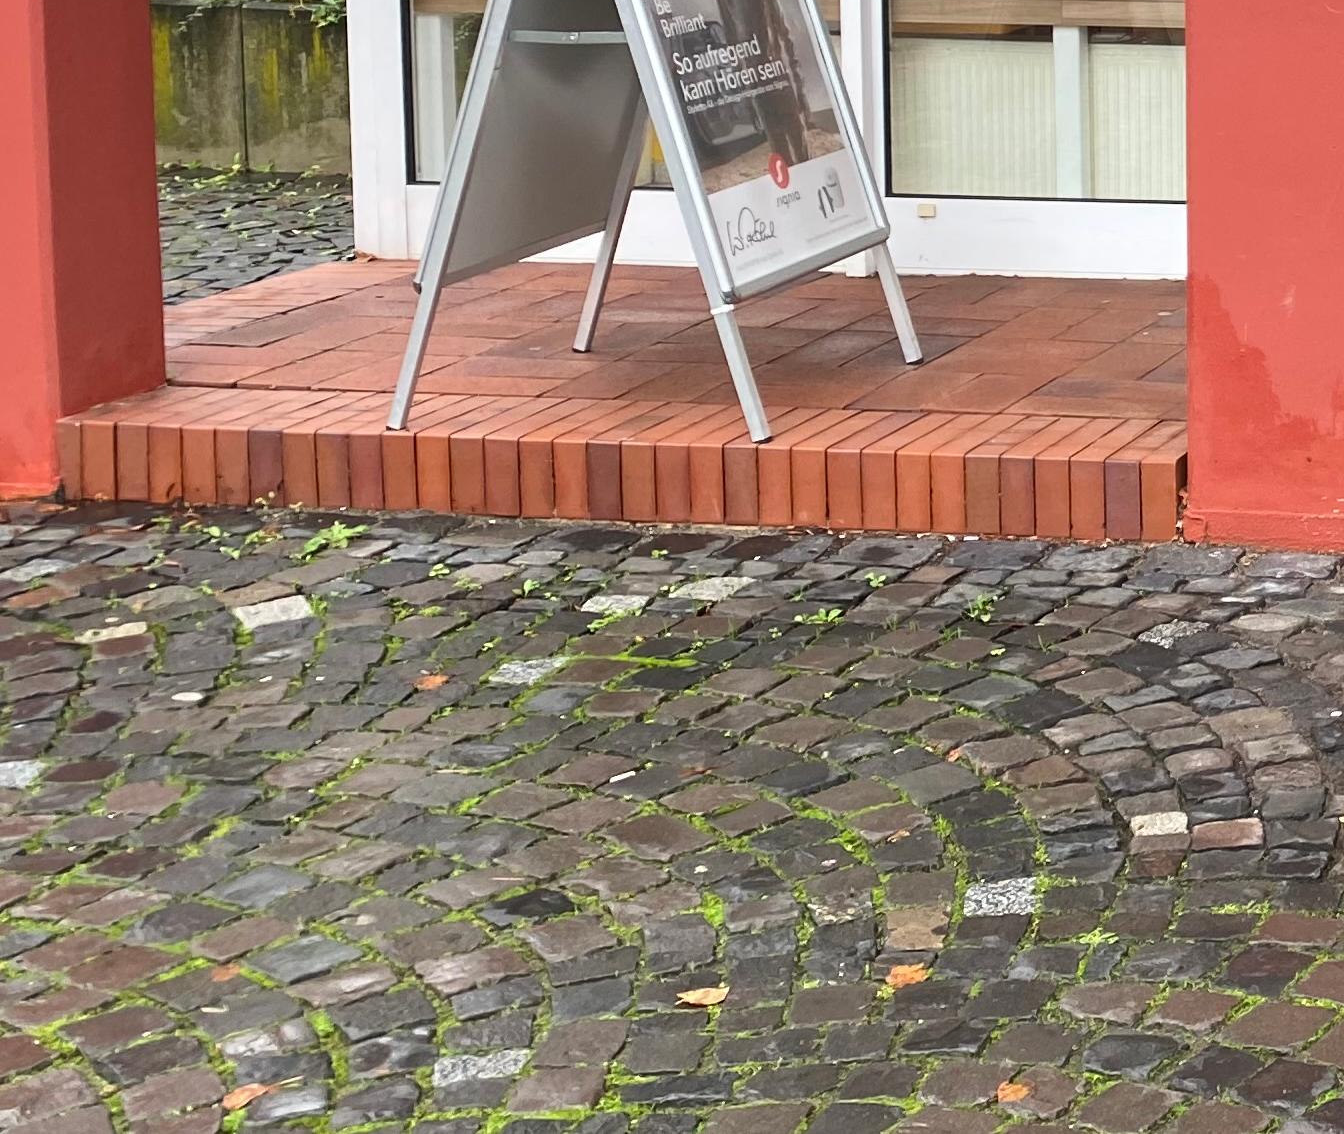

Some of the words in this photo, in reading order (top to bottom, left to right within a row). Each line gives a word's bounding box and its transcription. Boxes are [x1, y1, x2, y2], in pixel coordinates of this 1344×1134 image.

[659, 13, 707, 39] Brilliant
[672, 52, 694, 76] So
[693, 33, 761, 71] aufregend
[680, 73, 717, 103] kann
[713, 67, 760, 93] Hören
